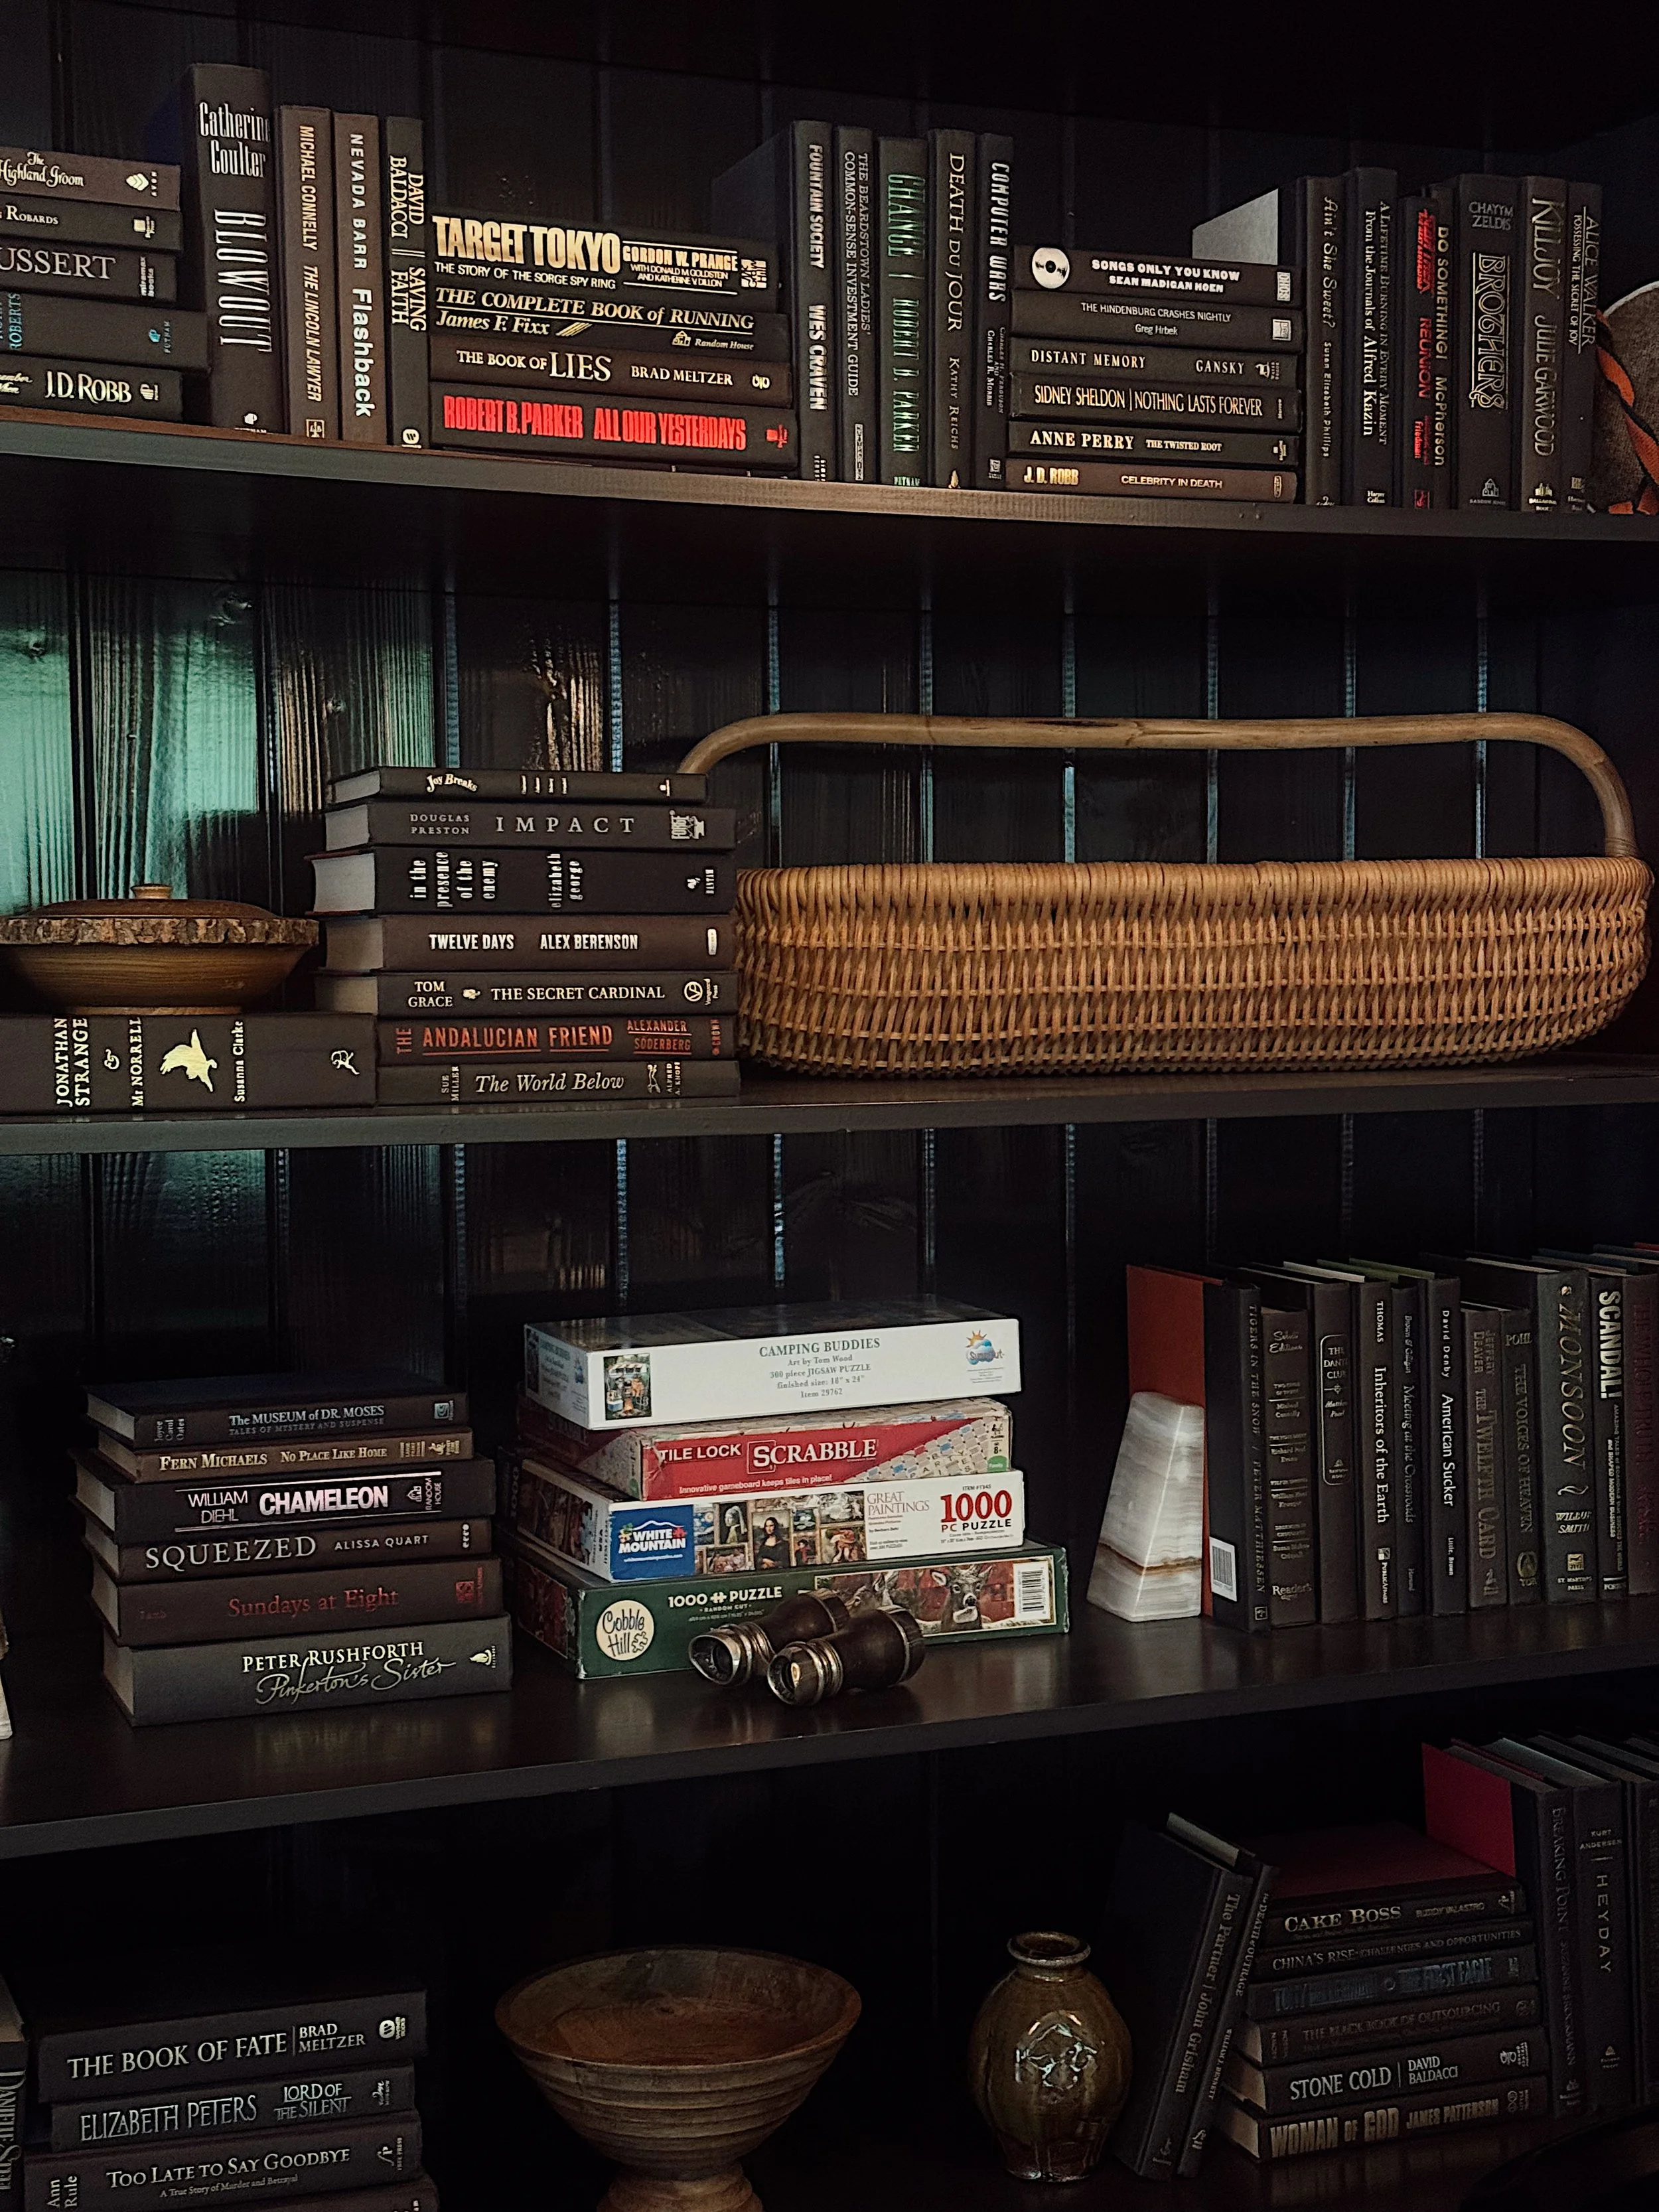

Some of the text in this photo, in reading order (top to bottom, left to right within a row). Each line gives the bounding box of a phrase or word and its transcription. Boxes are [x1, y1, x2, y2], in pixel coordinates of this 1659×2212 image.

[210, 139, 266, 178] Coulter
[299, 125, 318, 250] MICHAEL CONNELLY
[350, 134, 367, 269] NEVADA BARR
[390, 155, 408, 239] BALDACCI
[409, 173, 424, 224] DAVID
[809, 144, 824, 269] FOUNTAIN SOCIETY
[432, 215, 620, 274] TARGET TOKYO
[945, 153, 965, 331] DEATH DU JOUR
[214, 208, 272, 352] BLOWOUT
[434, 261, 616, 289] THE STORY OF THE SORGE SPY RING
[392, 270, 409, 325] FAITH
[409, 267, 426, 331] SAVING
[436, 288, 755, 329] THE COMPLETE BOOK of RUNNING
[1081, 303, 1232, 323] THE HINDENBURG CRASHES NIGHTLY
[304, 265, 321, 402] THE LINCOLN LAWYER
[695, 338, 755, 350] Random House
[1469, 252, 1508, 409] BROTHERS
[352, 288, 376, 417] Flashback
[456, 350, 612, 382] THE BOOK OF LIES
[809, 305, 827, 410] WES CRAVEN
[1031, 349, 1145, 368] DISTANT MEMORY
[1196, 360, 1244, 374] GANSKY
[631, 365, 733, 386] BRAD MELTZER
[1363, 335, 1378, 436] Alfred Kazin
[1534, 315, 1555, 456] JULIE GARWOOD
[1035, 384, 1125, 408] SIDNEY SHELDON
[593, 407, 747, 451] ALL OUR YESTERDAYS
[1434, 376, 1447, 466] McPherson
[1030, 430, 1134, 450] ANNE PERRY
[1121, 475, 1223, 488] CELEBRITY IN DEATH
[409, 814, 470, 822] DOUGLAS
[411, 826, 469, 835] PRESTON
[496, 816, 634, 833] IMPACT
[428, 934, 514, 950] TWELVE DAYS
[540, 934, 638, 950] ALEX BERENSON
[414, 981, 445, 992] TOM
[490, 986, 666, 1001] THE SECRET CARDINAL
[407, 996, 453, 1007] GRACE
[396, 1028, 412, 1055] THE
[423, 1025, 613, 1048] ANDALUCIAN FRIEND
[54, 1018, 73, 1108] JONATHAN
[72, 1017, 90, 1106] STRANGE
[105, 1049, 120, 1070] &
[129, 1017, 143, 1106] Mr NORRELL
[231, 1021, 246, 1102] Susanna Clarke
[475, 1072, 624, 1092] The World Below
[759, 1337, 881, 1357] CAMPING BUDDIES
[1441, 1310, 1451, 1378] David Denby
[1599, 1291, 1621, 1399] SCANDAL!
[1374, 1366, 1387, 1435] Inheritors
[229, 1414, 249, 1427] The
[252, 1410, 305, 1424] MUSEUM
[308, 1409, 319, 1420] of
[344, 1405, 385, 1417] MOSES
[660, 1443, 741, 1462] TILE LOCK
[1376, 1439, 1388, 1453] of
[1441, 1394, 1457, 1507] American Sucker
[1376, 1457, 1389, 1479] the
[187, 1490, 248, 1508] WILLIAM
[259, 1486, 388, 1516] CHAMELEON
[868, 1492, 904, 1505] GREAT
[868, 1501, 930, 1514] PAINTINGS
[941, 1489, 1013, 1523] 1000
[1376, 1483, 1390, 1523] Earth
[201, 1509, 239, 1524] DIEHL
[942, 1518, 1011, 1532] PC PUZZLE
[334, 1534, 429, 1550] ALISSA QUART
[618, 1537, 686, 1553] MOUNTAIN
[633, 1528, 673, 1541] WHITE
[145, 1536, 316, 1572] SQUEEZED
[668, 1586, 782, 1607] 1000 PUZZLE
[603, 1607, 645, 1633] Cobble
[242, 1642, 423, 1672] PETER RUSHFORTH
[609, 1633, 630, 1656] Hill
[1596, 1874, 1611, 1972] HEYDAY
[66, 2032, 287, 2079] THE BOOK OF FATE
[1408, 2056, 1441, 2072] DAVID
[1289, 2068, 1392, 2101] STONE COLD
[1409, 2067, 1458, 2084] BALDACCI
[80, 2095, 257, 2142] ELIZABETH PETERS
[47, 2179, 60, 2208] Ann
[64, 2175, 78, 2208] Rule
